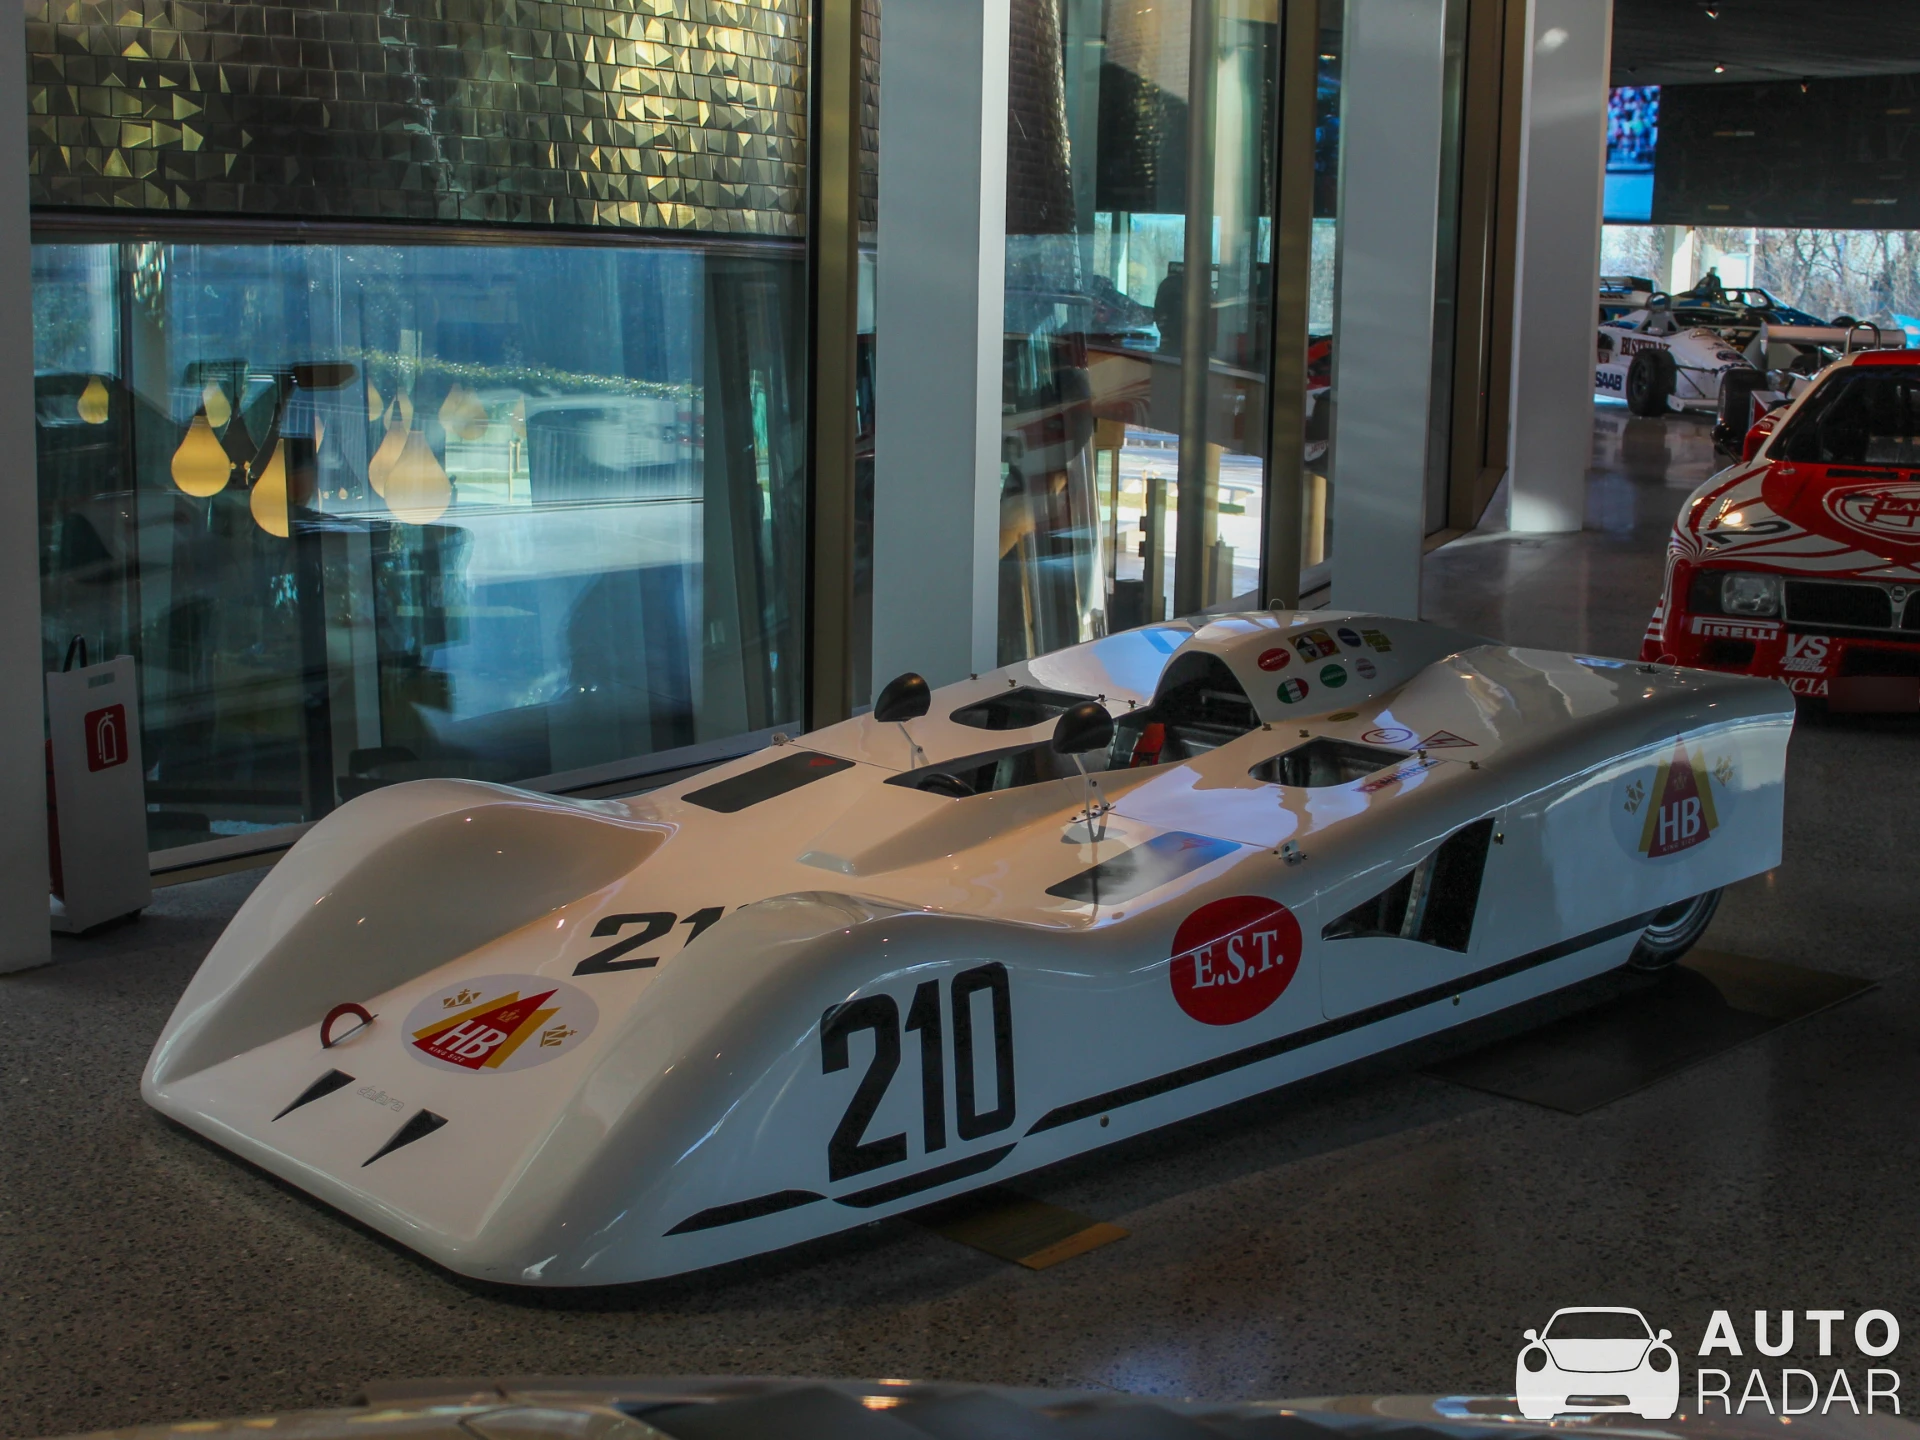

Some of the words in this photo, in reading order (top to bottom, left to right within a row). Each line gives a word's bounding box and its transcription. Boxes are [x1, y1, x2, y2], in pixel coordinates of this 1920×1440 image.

[1596, 371, 1622, 391] SAAB
[1880, 501, 1920, 512] LA
[1690, 616, 1781, 640] PIRELLI
[1785, 633, 1831, 659] VS
[1659, 796, 1701, 846] HB
[572, 904, 749, 977] 21
[1190, 930, 1285, 990] E.S.T.
[428, 1046, 448, 1056] KING
[447, 1053, 466, 1063] SIZE
[432, 1019, 508, 1059] HB
[820, 962, 1016, 1184] 210
